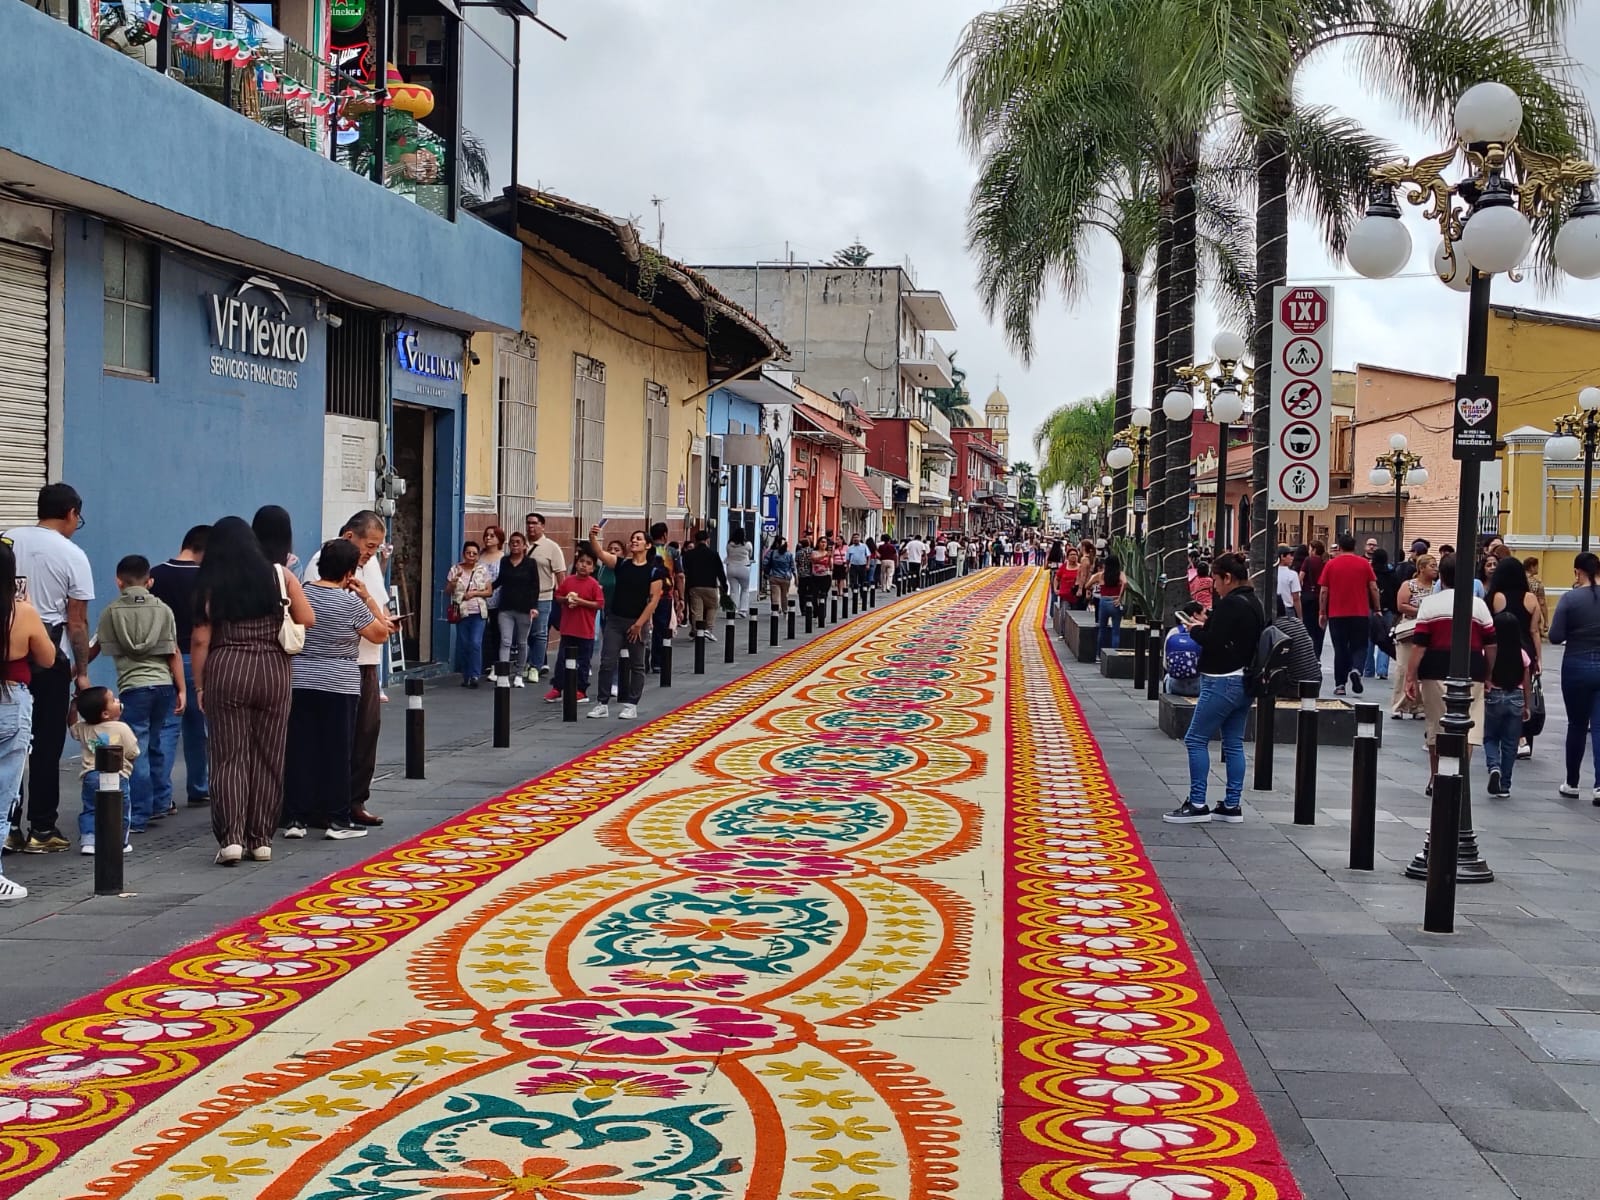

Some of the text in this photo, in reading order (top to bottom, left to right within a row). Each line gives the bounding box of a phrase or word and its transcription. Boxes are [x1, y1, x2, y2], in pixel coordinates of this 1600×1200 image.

[330, 7, 362, 16] ineken
[1295, 291, 1314, 300] ALTO
[402, 332, 460, 381] CULLINAN
[210, 355, 298, 389] SERVICIOS FINANCIEROS
